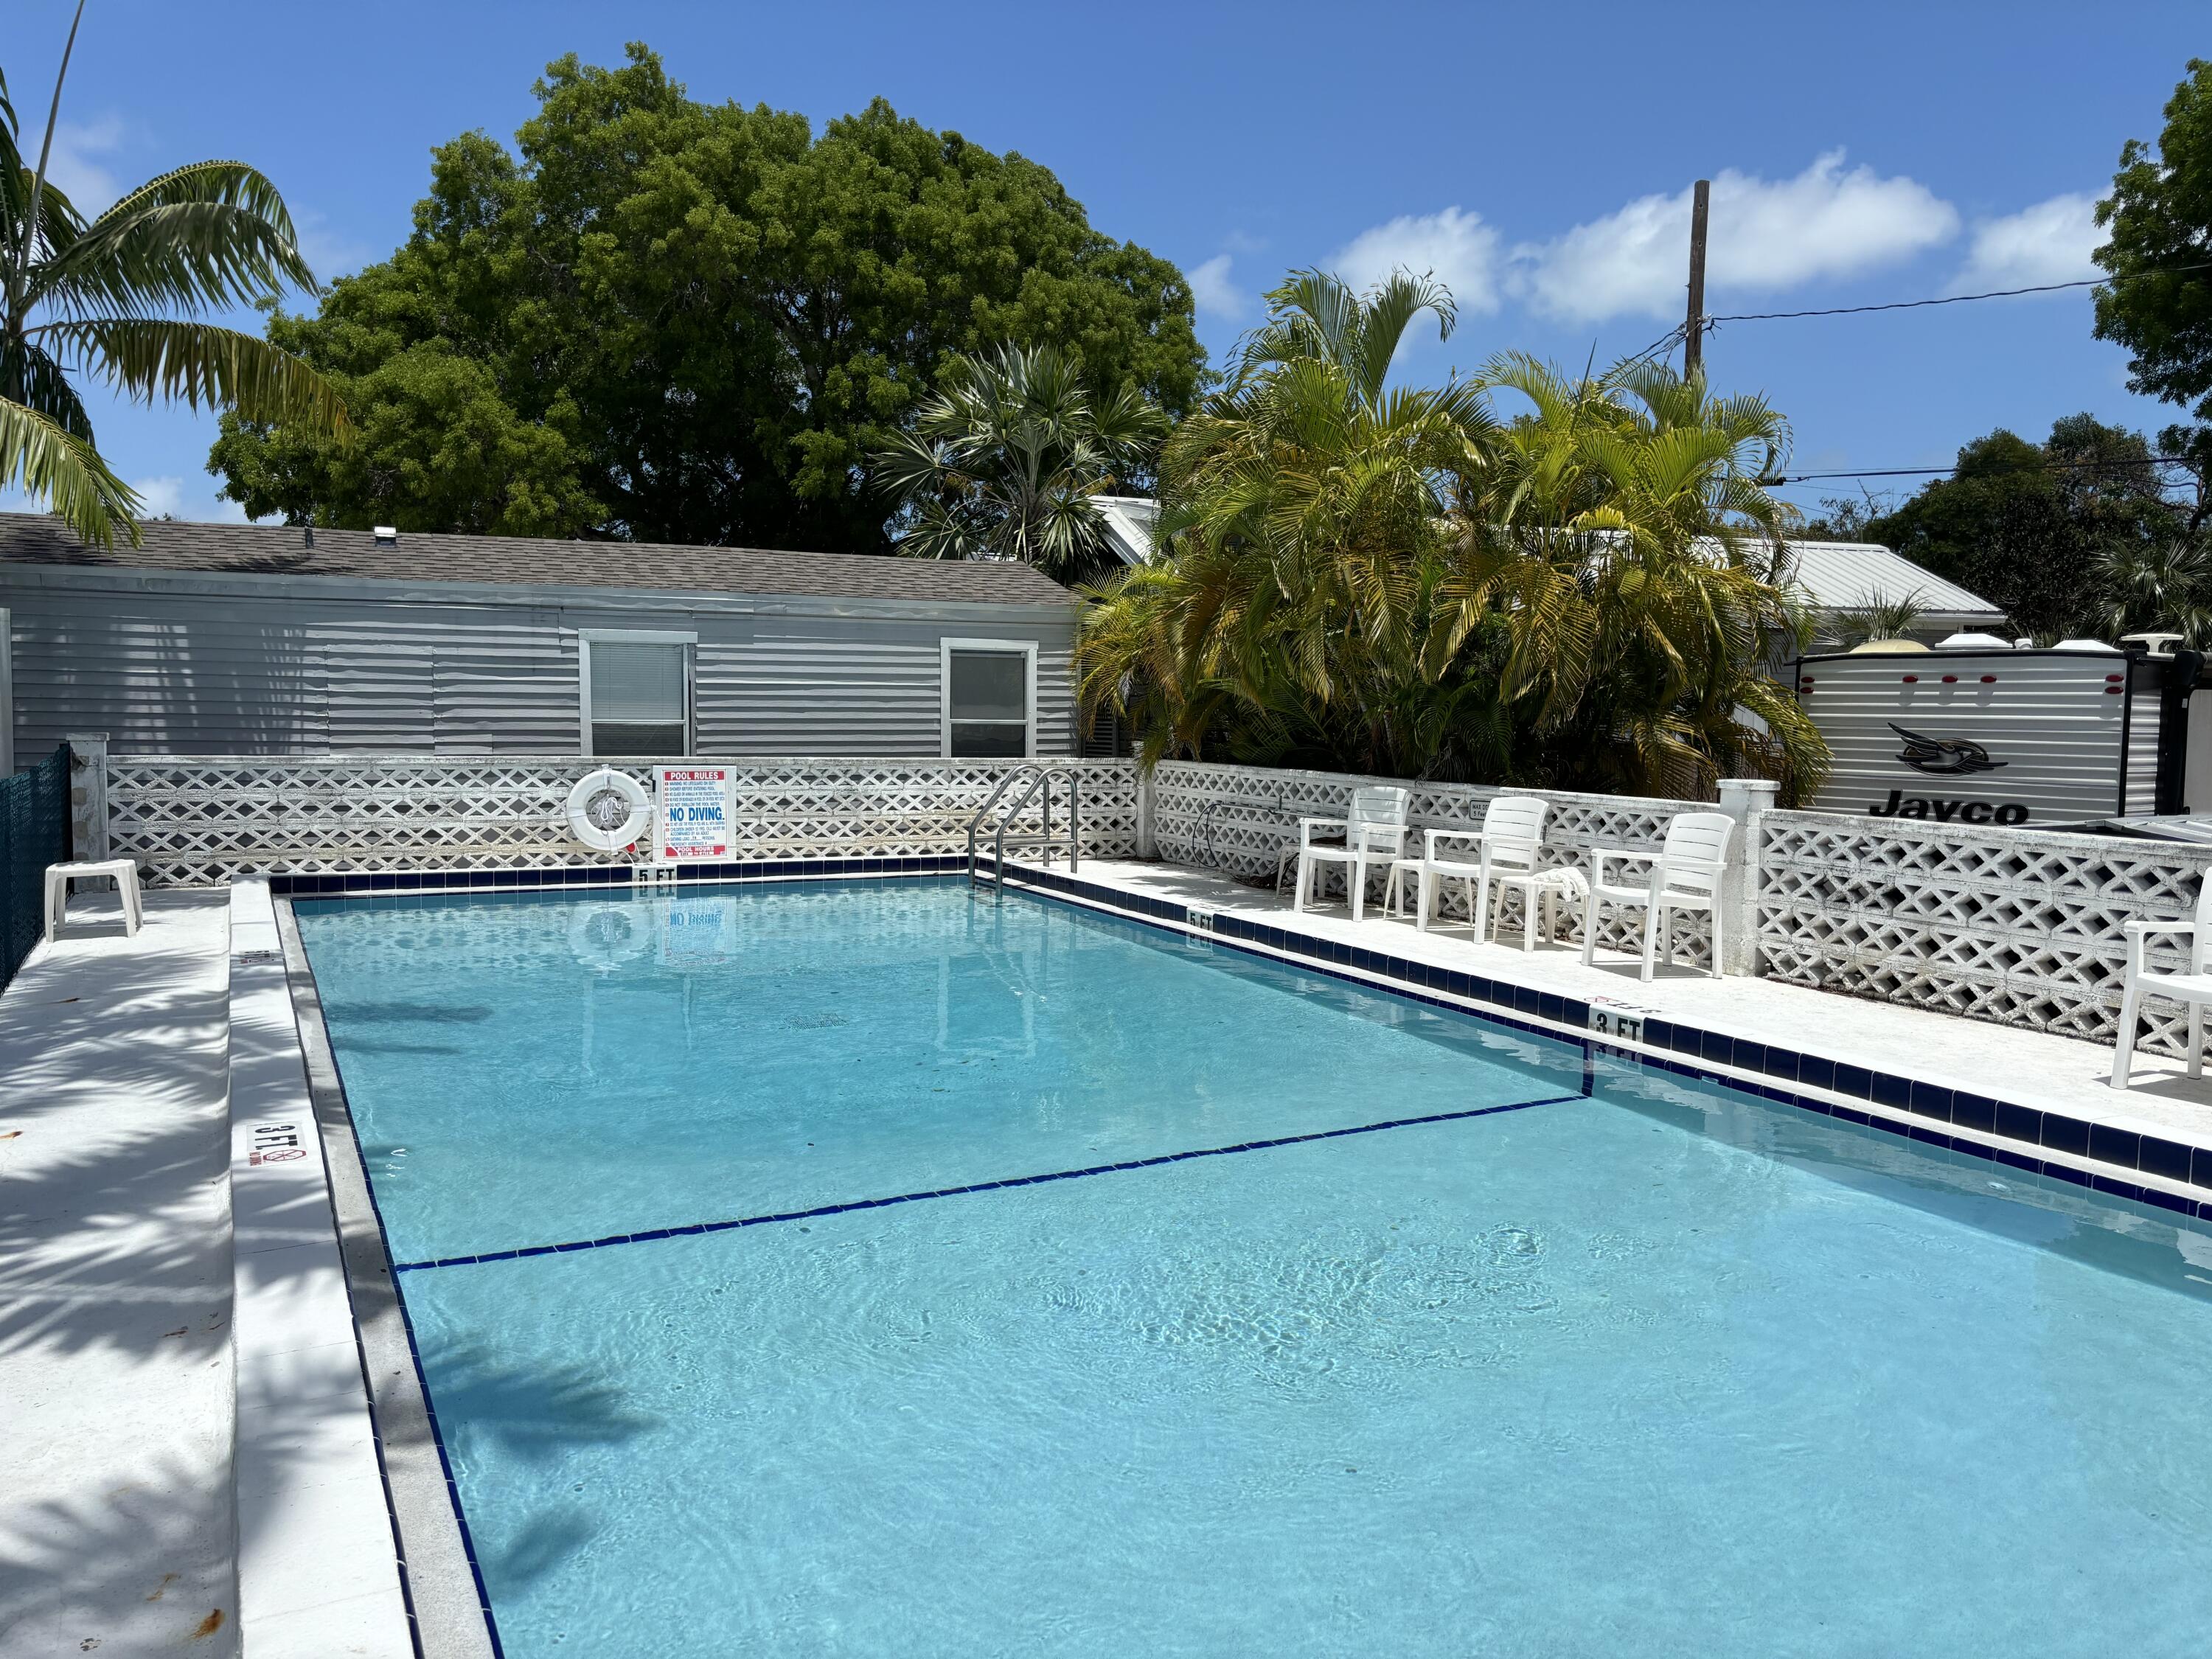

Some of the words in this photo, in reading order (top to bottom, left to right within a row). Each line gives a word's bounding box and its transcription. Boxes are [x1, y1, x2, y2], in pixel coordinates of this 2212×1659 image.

[670, 772, 691, 780] POOL
[694, 771, 718, 779] RULES
[669, 807, 684, 821] NO
[689, 807, 725, 821] DIVING.
[639, 869, 648, 882] 5
[656, 869, 675, 881] FT
[1190, 912, 1195, 926] 5
[1200, 914, 1211, 931] FT
[1596, 1013, 1607, 1034] 3
[1617, 1017, 1641, 1041] FT
[255, 1125, 296, 1133] 3
